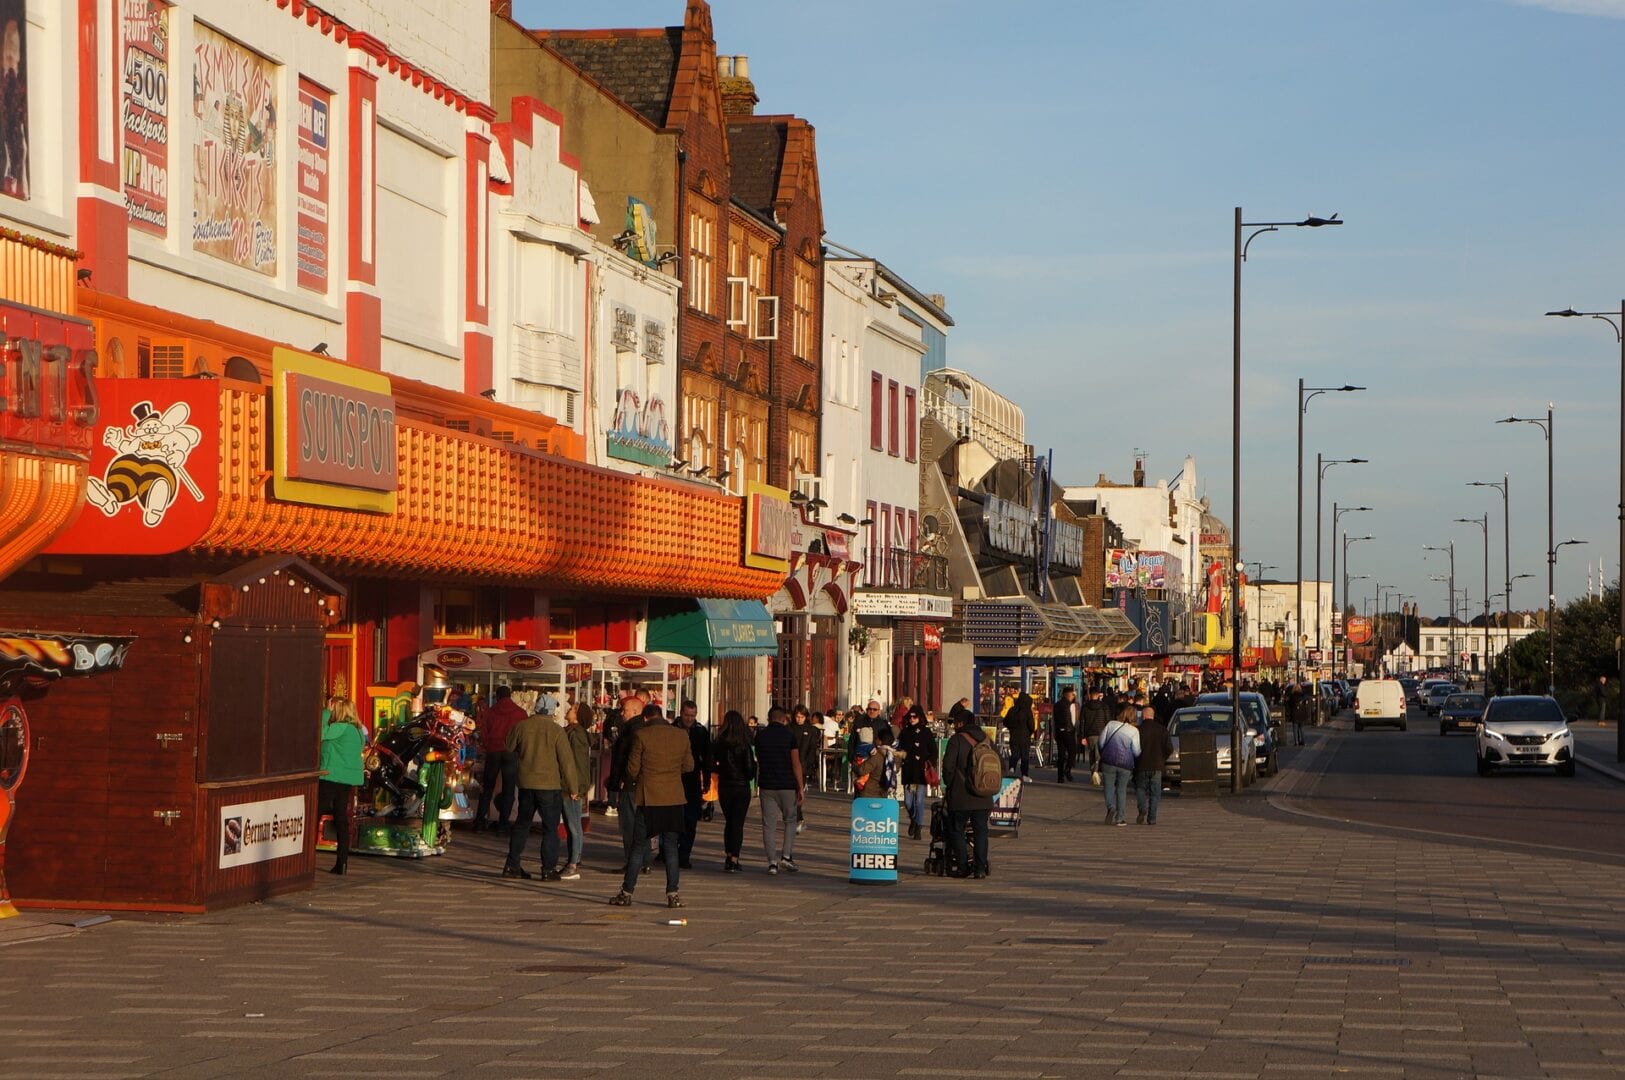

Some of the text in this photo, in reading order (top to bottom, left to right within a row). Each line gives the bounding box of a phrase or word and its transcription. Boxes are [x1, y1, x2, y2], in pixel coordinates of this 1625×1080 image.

[123, 97, 168, 144] Jackpots
[140, 153, 168, 199] Area
[204, 140, 264, 214] TICKETS
[0, 331, 99, 427] NTS
[302, 388, 394, 475] SUNSPOT
[243, 811, 303, 846] German Sausages
[852, 816, 897, 834] Cash
[852, 834, 897, 845] Machine
[853, 854, 895, 869] HERE
